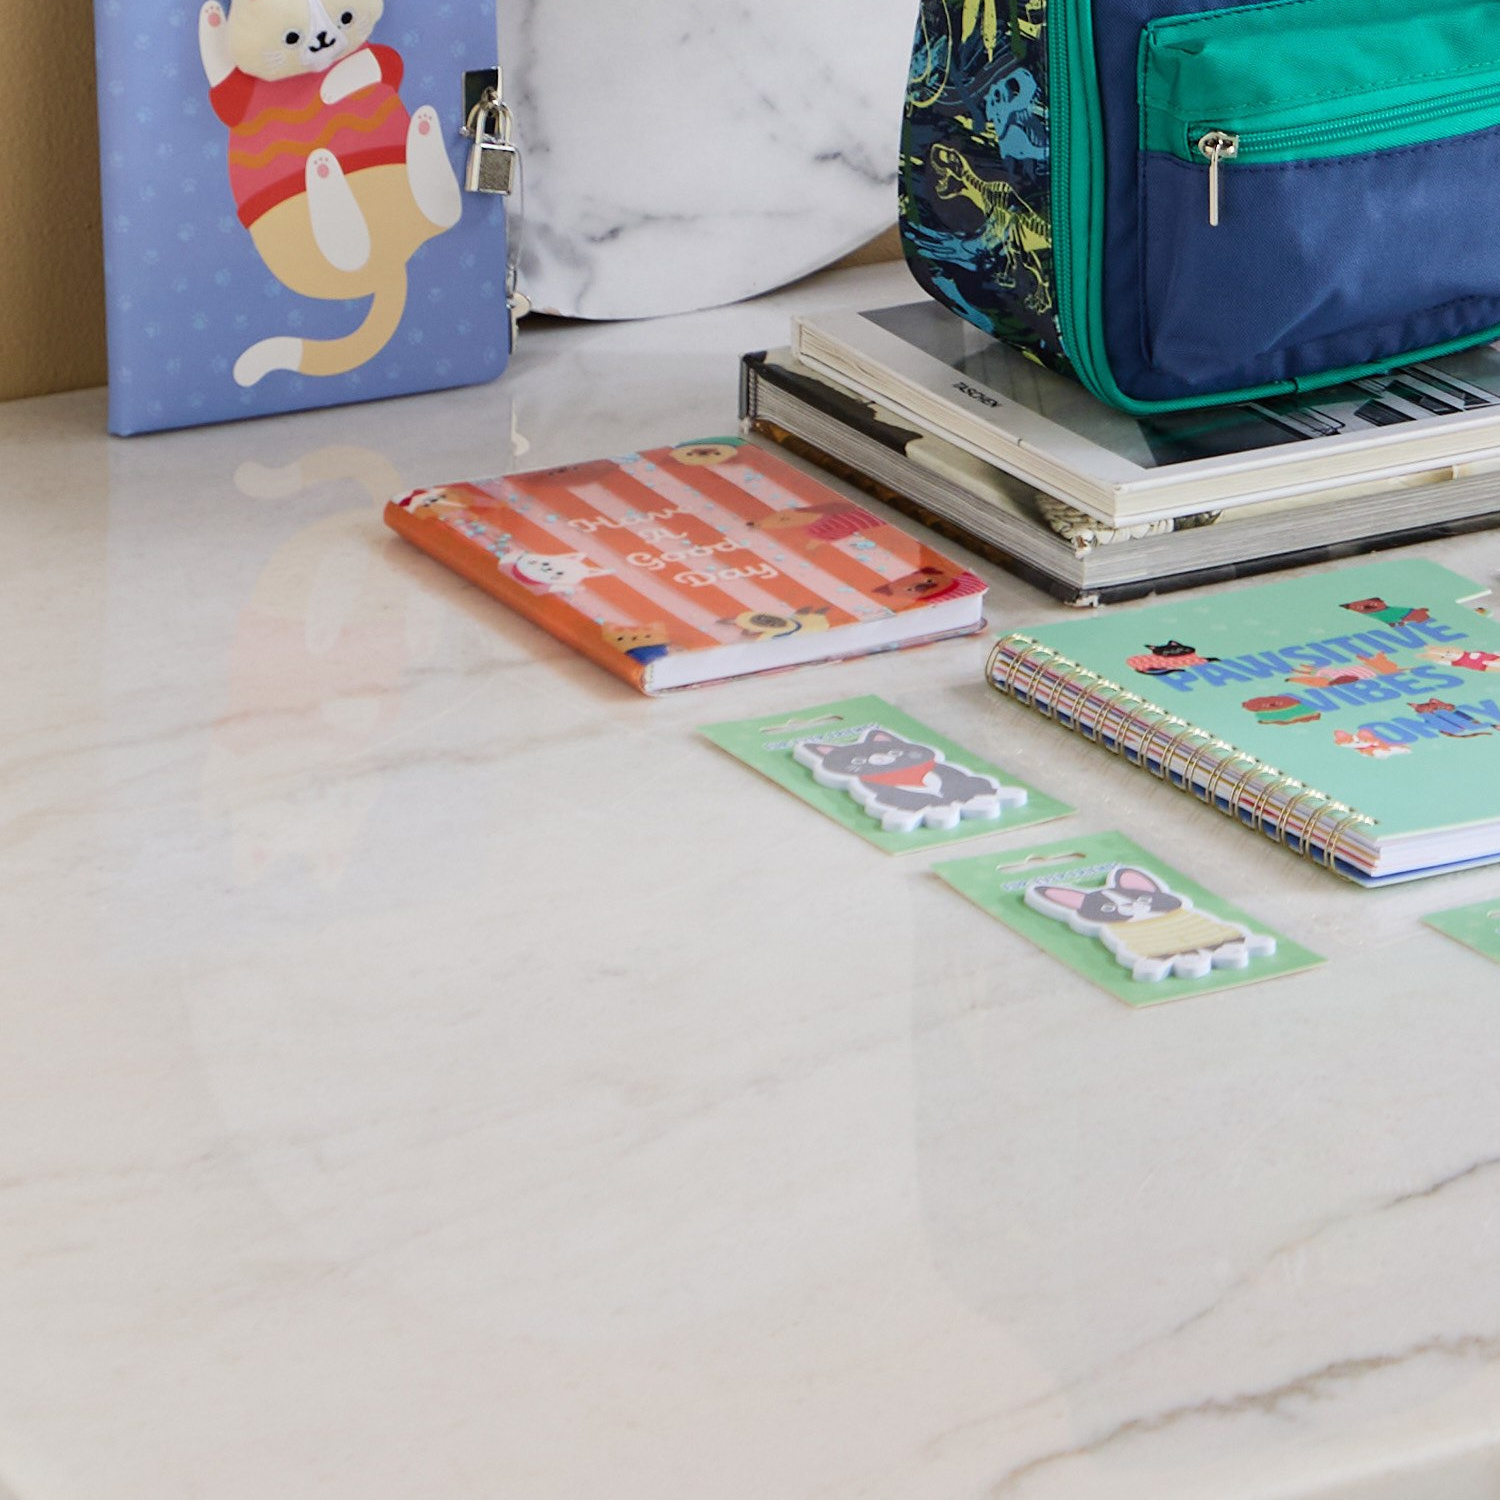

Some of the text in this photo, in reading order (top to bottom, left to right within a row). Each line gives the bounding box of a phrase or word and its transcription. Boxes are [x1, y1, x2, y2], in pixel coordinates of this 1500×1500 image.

[625, 537, 747, 571] Good
[673, 562, 779, 587] Day
[1147, 618, 1468, 692] PAWSITIVE
[1277, 665, 1464, 712] VIBES
